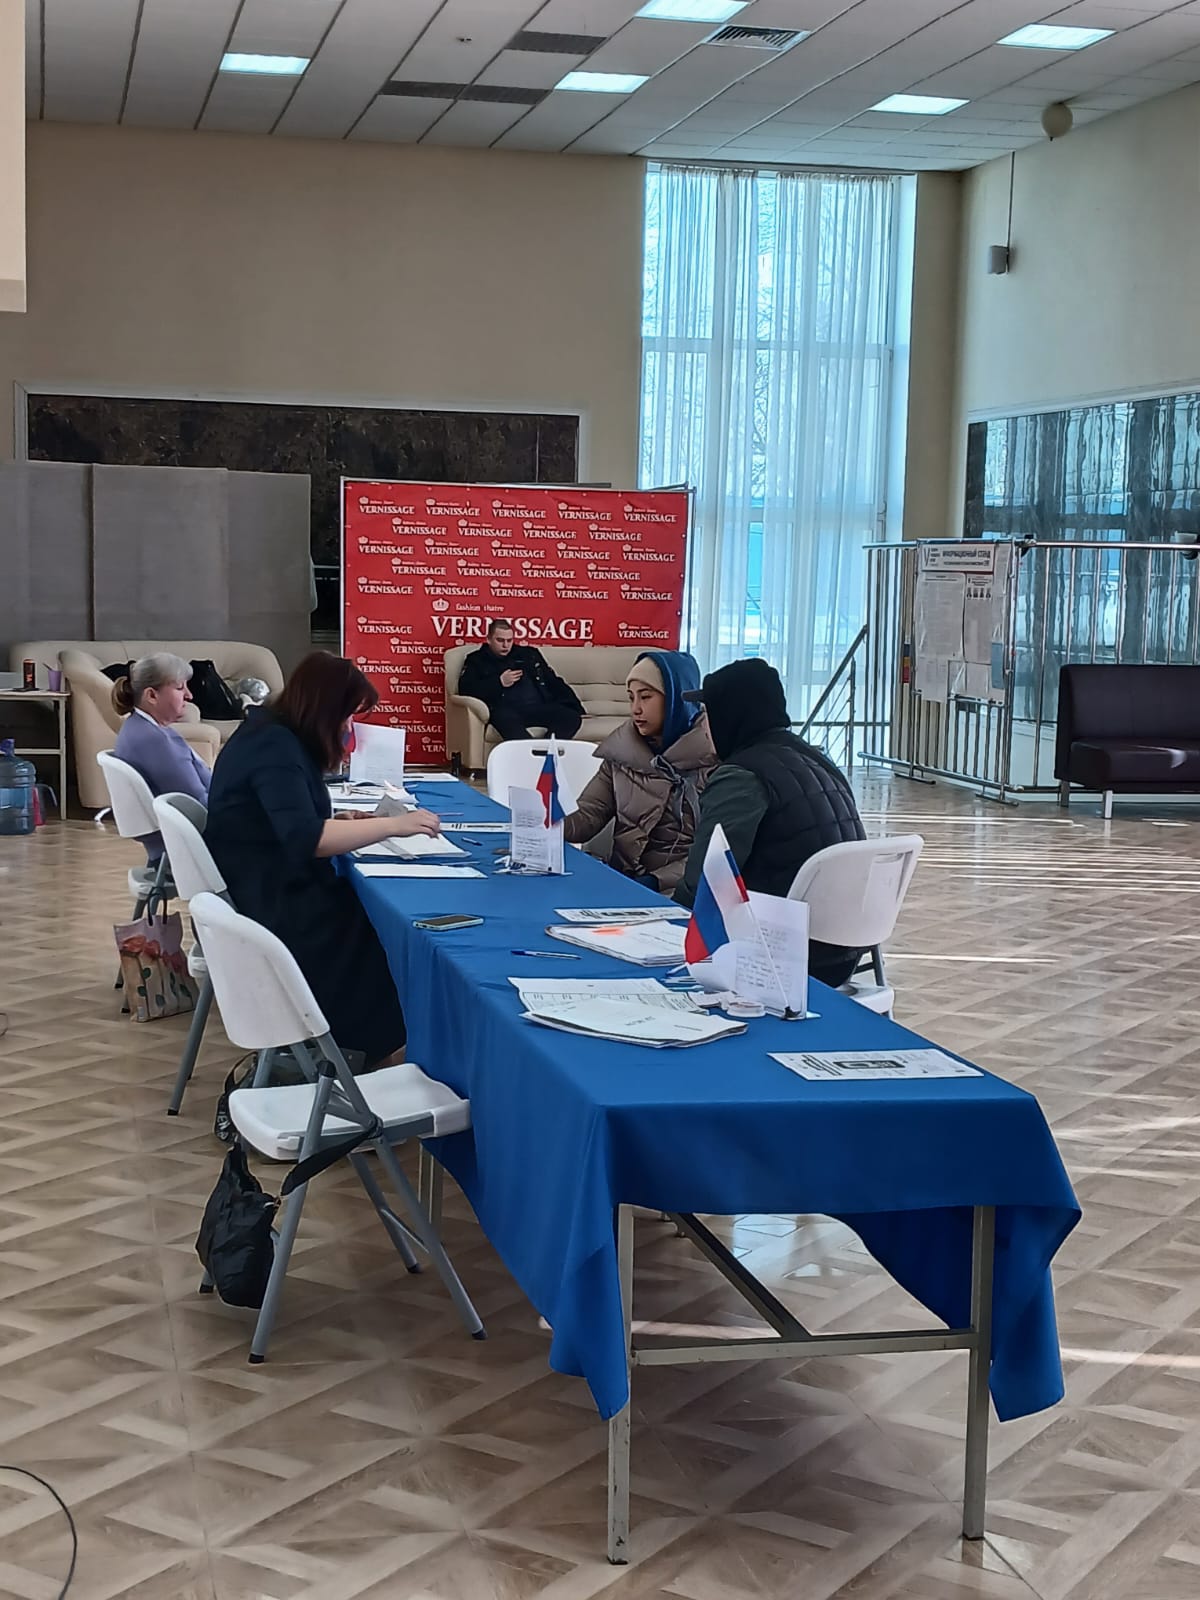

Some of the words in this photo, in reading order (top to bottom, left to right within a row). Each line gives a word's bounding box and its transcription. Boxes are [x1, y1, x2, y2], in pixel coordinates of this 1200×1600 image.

[359, 505, 415, 514] VERNISSAGE
[426, 506, 480, 516] VERNISSAGE
[492, 508, 546, 518] VERNISSAGE
[558, 511, 612, 521] VERNISSAGE
[623, 513, 676, 523] VERNISSAGE
[392, 525, 447, 535] VERNISSAGE
[458, 527, 513, 537] VERNISSAGE
[523, 529, 577, 539] VERNISSAGE
[589, 531, 642, 541] VERNISSAGE
[359, 545, 414, 555] VERNISSAGE
[425, 546, 480, 556] VERNISSAGE
[491, 548, 545, 558] VERNISSAGE
[557, 550, 610, 560] VERNISSAGE
[622, 552, 675, 562] VERNISSAGE
[391, 566, 446, 575] VERNISSAGE
[457, 567, 511, 577] VERNISSAGE
[522, 569, 575, 579] VERNISSAGE
[587, 571, 640, 580] VERNISSAGE
[358, 585, 413, 594] VERNISSAGE
[424, 586, 478, 596] VERNISSAGE
[490, 588, 544, 598] VERNISSAGE
[555, 590, 609, 599] VERNISSAGE
[620, 591, 672, 601] VERNISSAGE
[357, 625, 412, 634] VERNISSAGE
[618, 630, 669, 639] VERNISSAGE
[390, 645, 445, 654] VERNISSAGE
[389, 685, 443, 694] VERNISSAGE
